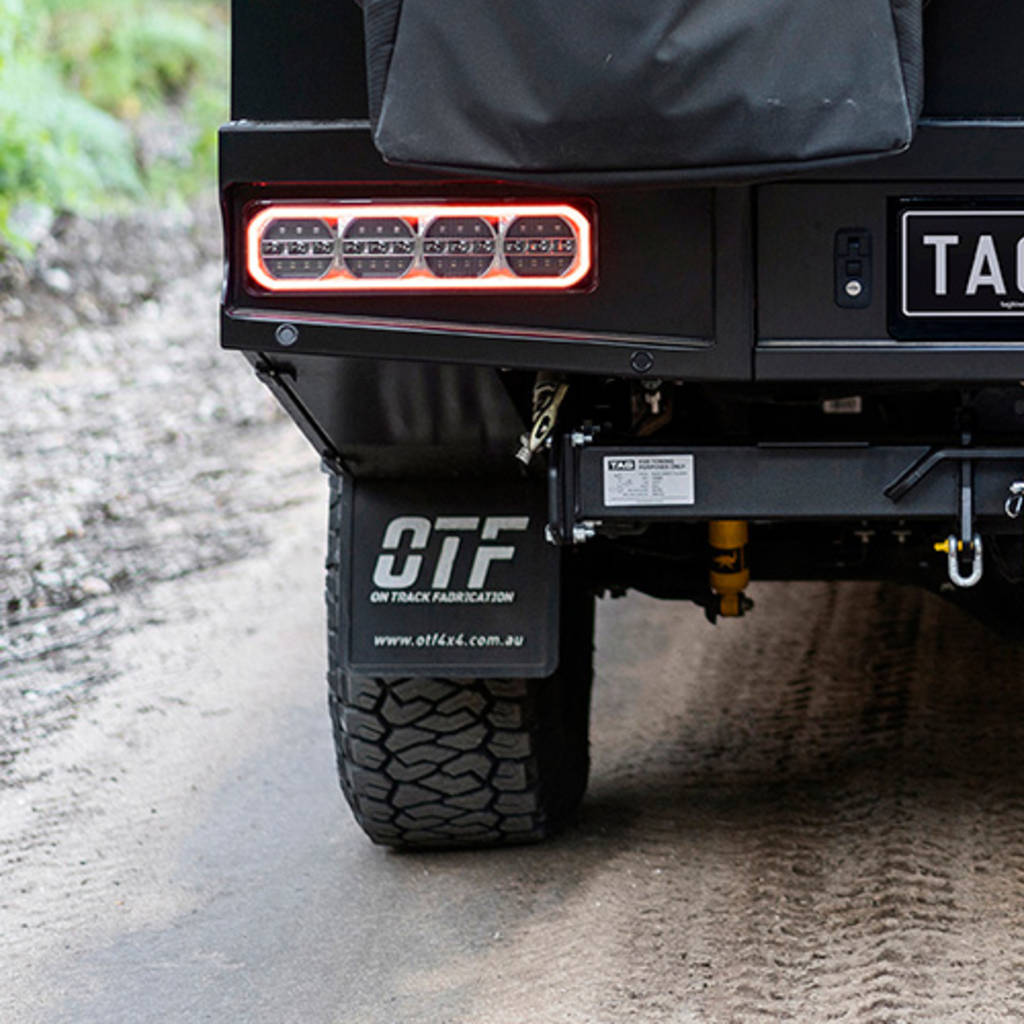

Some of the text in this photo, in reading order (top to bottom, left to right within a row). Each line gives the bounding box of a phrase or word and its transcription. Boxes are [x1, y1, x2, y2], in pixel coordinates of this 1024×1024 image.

[372, 516, 530, 590] OTF
[370, 591, 515, 603] ON TRACK FABRICATION
[374, 633, 525, 647] www.otf4x4.com.au
